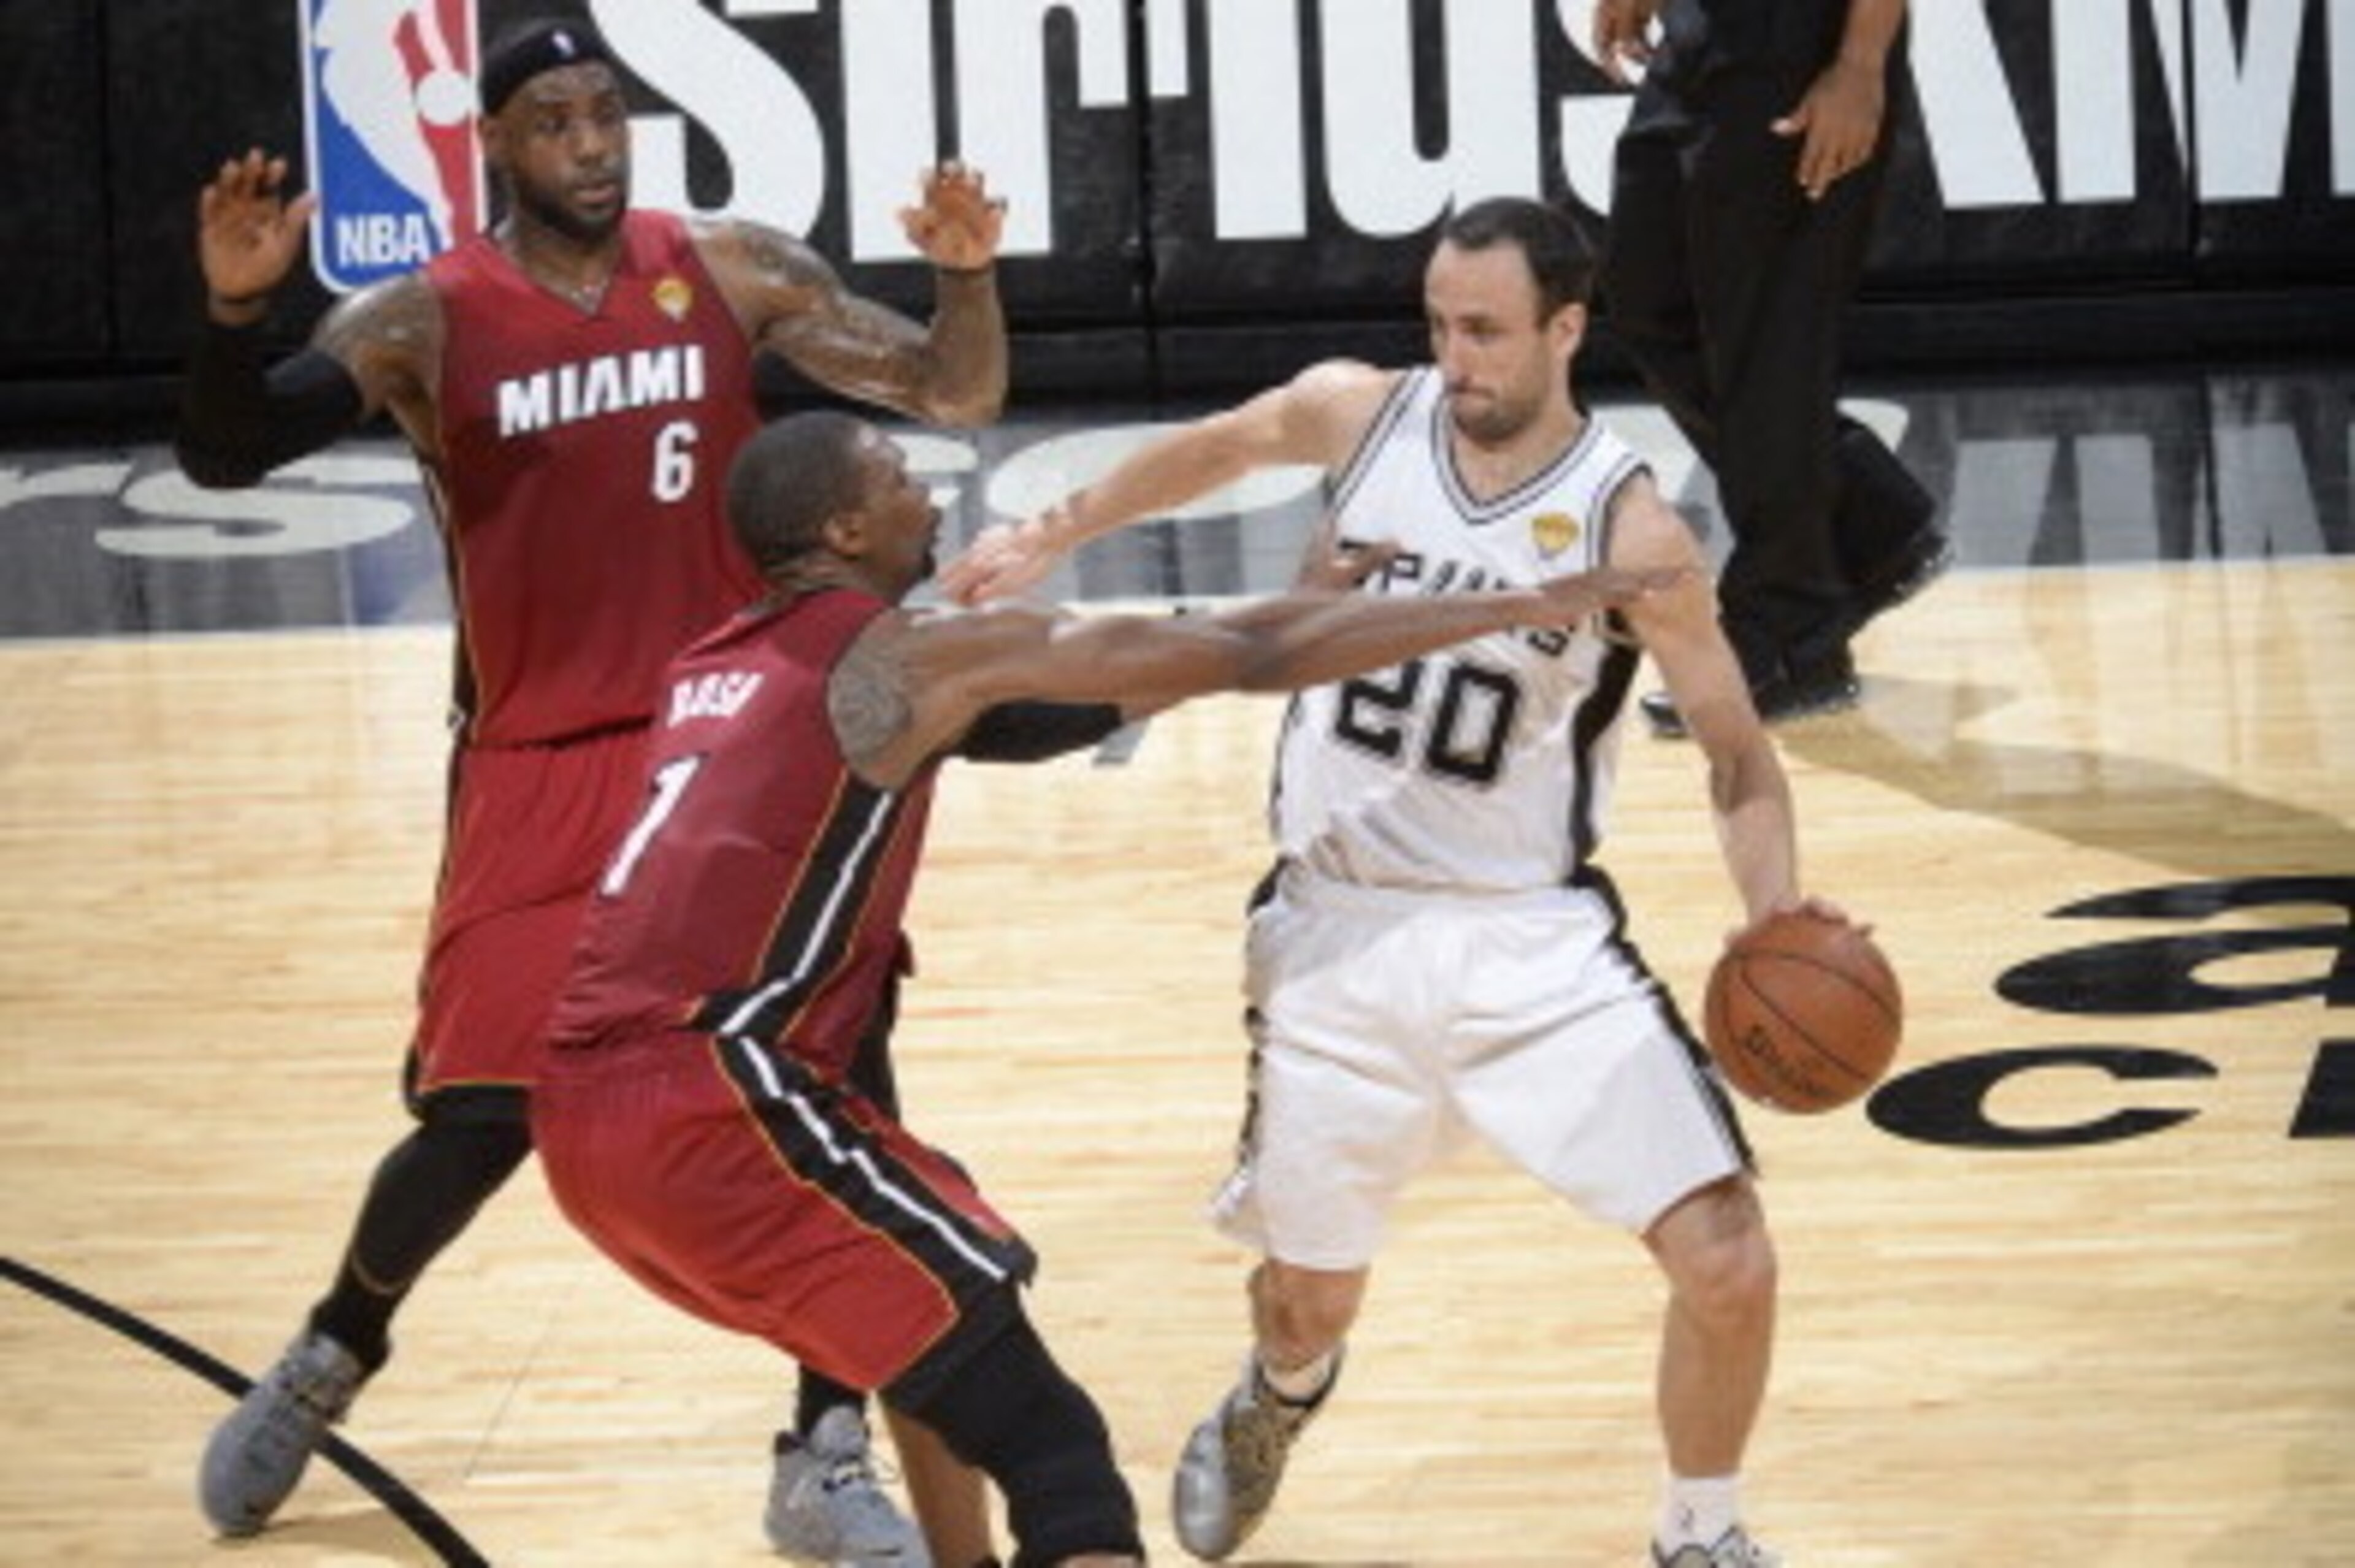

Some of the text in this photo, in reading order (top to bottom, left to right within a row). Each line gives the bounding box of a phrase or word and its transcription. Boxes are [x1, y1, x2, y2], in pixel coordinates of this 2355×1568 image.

[335, 214, 431, 269] NBA
[498, 343, 705, 438] MIAMI
[653, 420, 699, 503] 6
[1332, 657, 1521, 782] 20
[600, 755, 702, 897] 1
